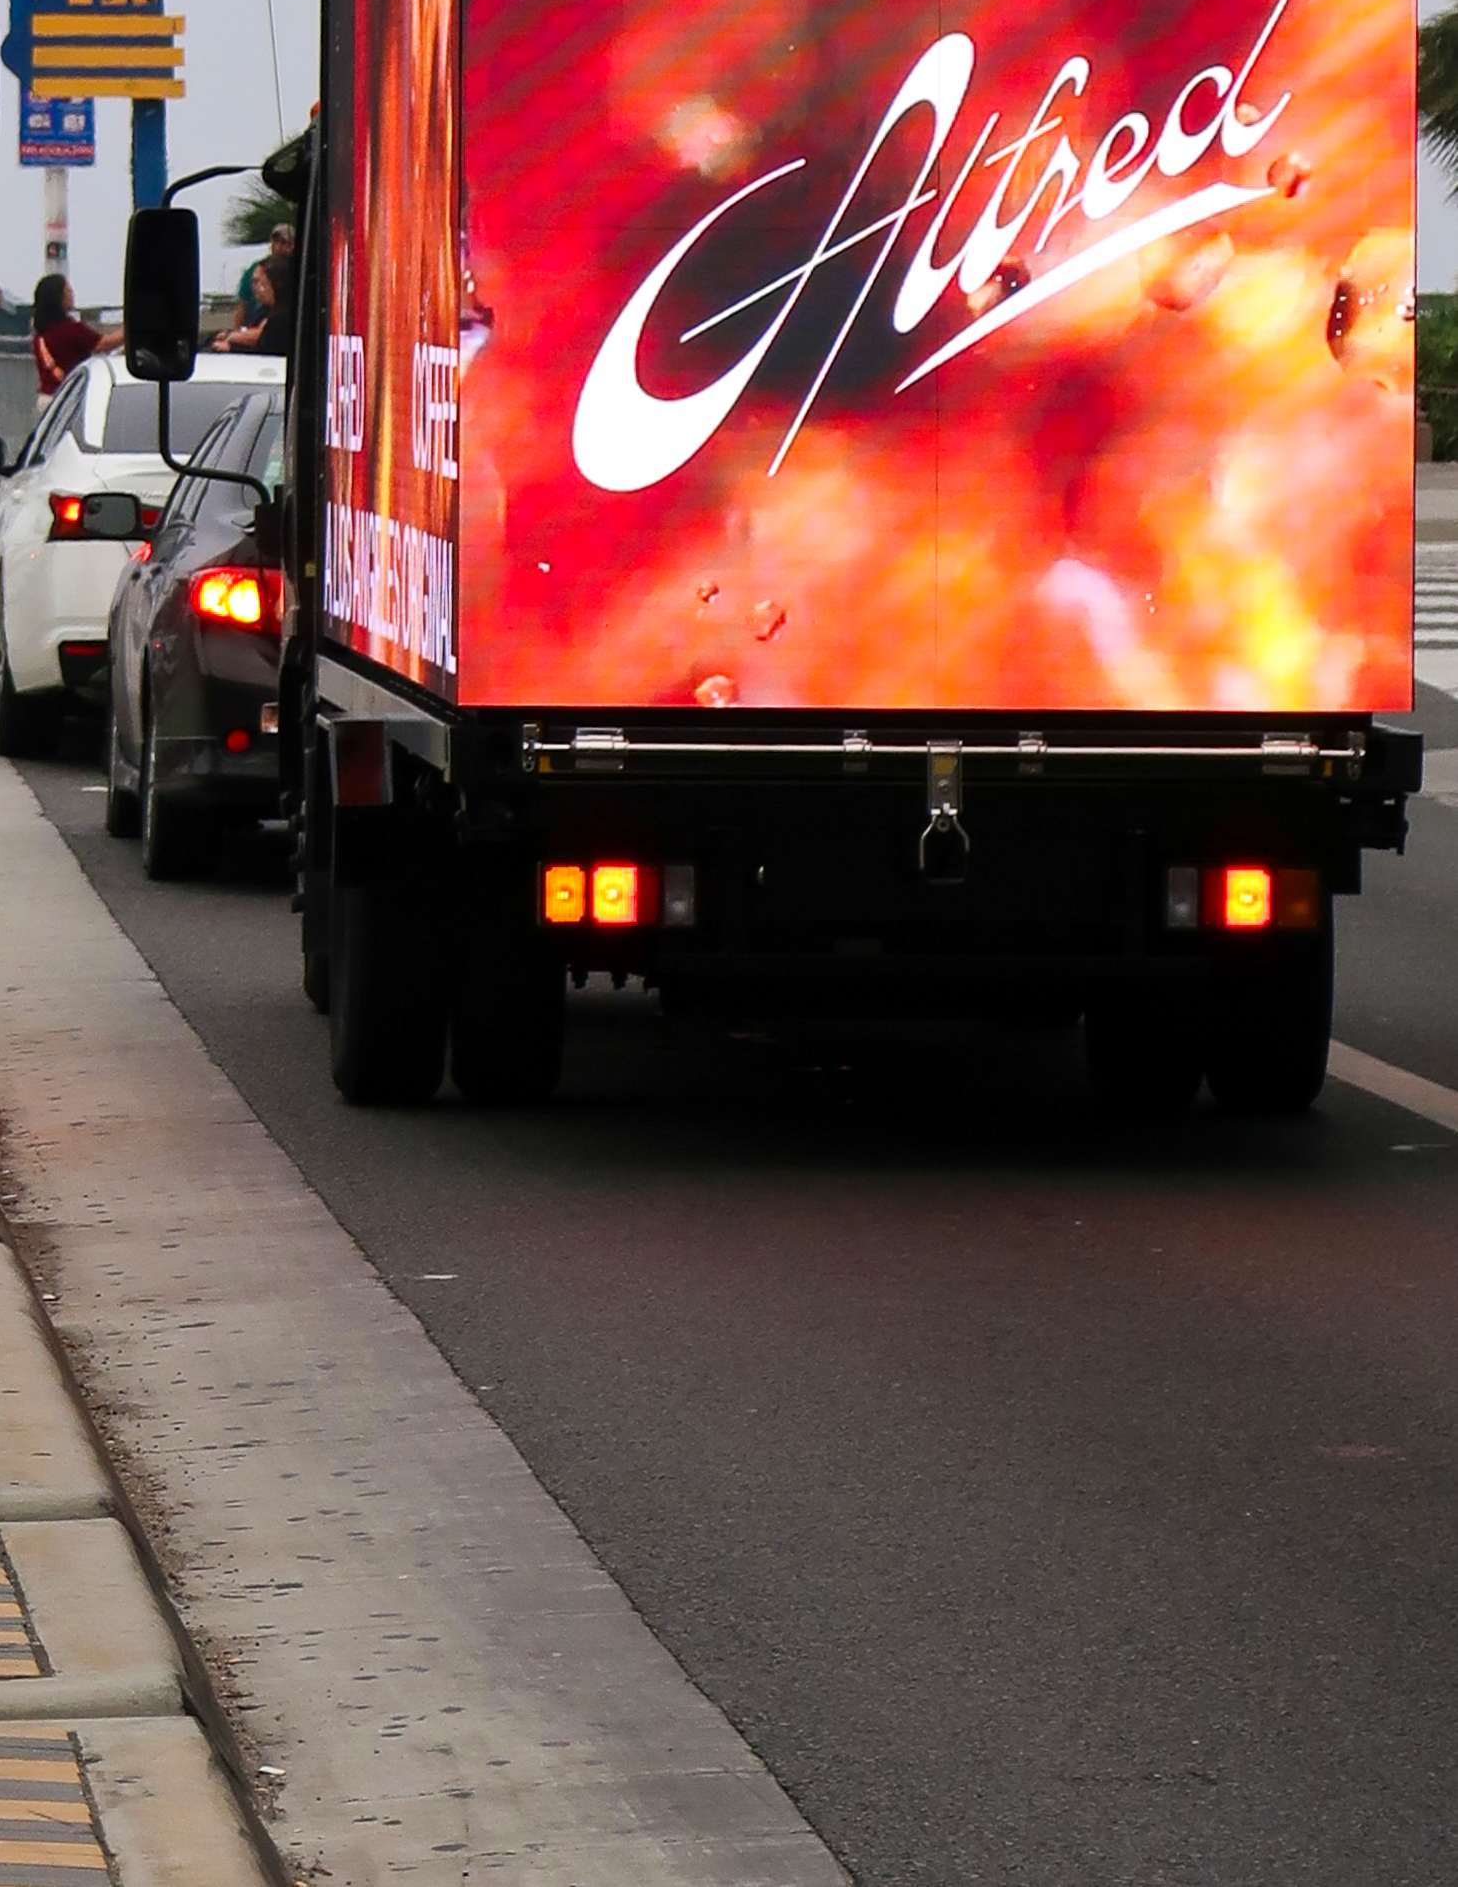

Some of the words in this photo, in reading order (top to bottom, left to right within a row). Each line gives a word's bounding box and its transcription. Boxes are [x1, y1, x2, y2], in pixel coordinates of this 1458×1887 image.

[325, 334, 365, 453] ALFRED
[411, 341, 459, 480] COFFEE
[401, 523, 458, 675] ORIGINAL
